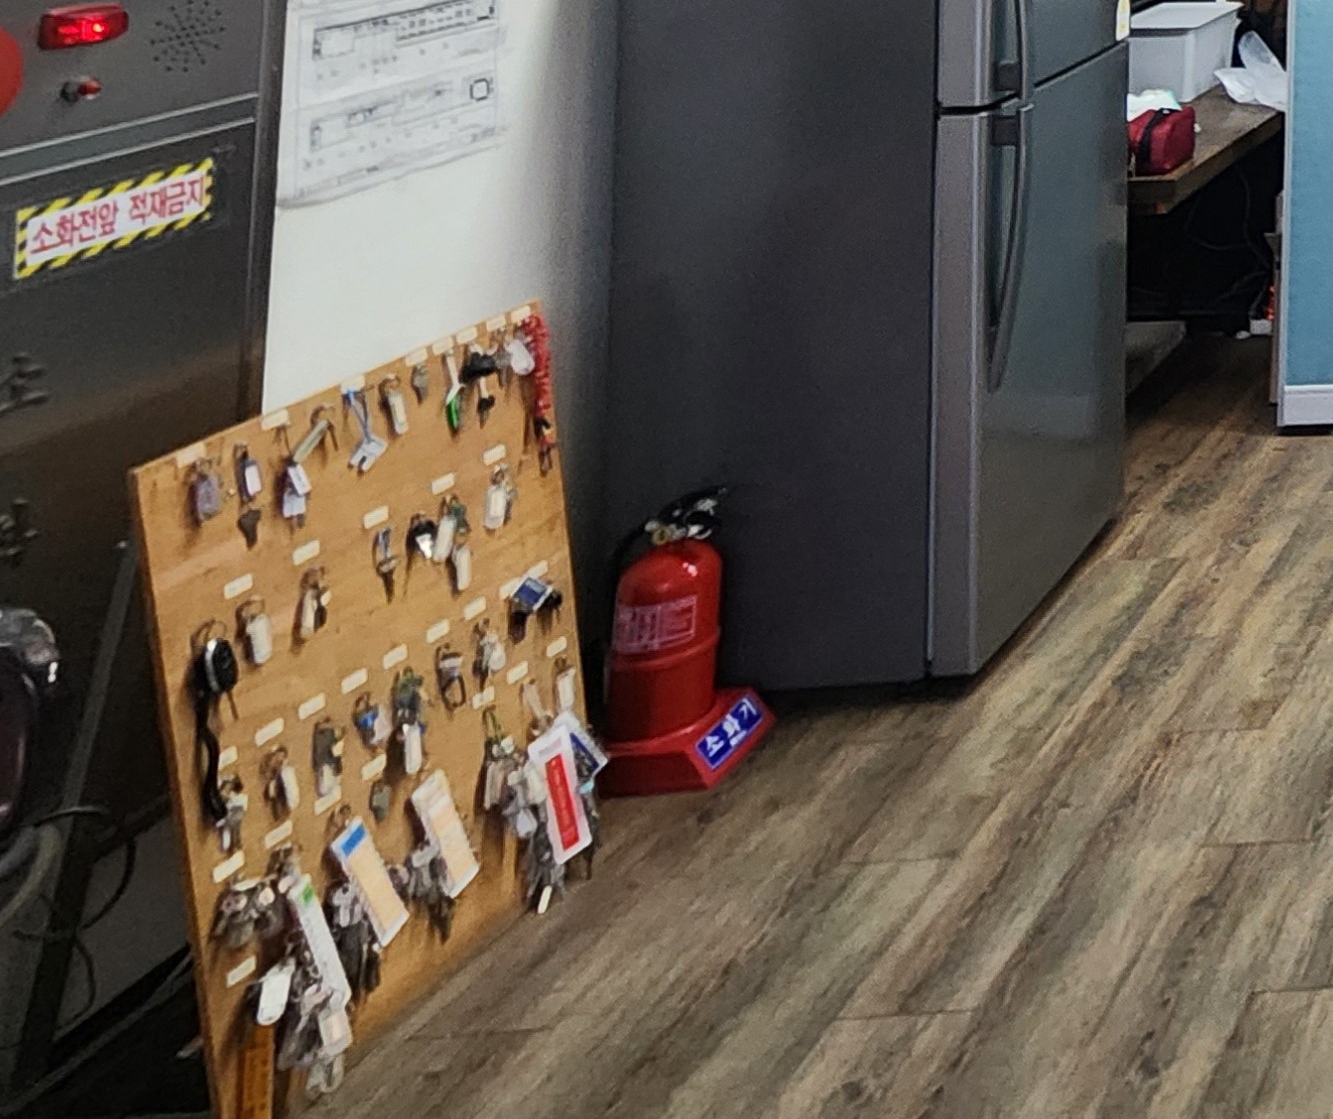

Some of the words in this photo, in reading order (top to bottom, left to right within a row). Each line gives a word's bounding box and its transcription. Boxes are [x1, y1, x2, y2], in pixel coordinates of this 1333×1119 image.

[30, 200, 119, 254] 소화전앞
[129, 177, 206, 224] 적재금지
[706, 697, 758, 757] 소화기
